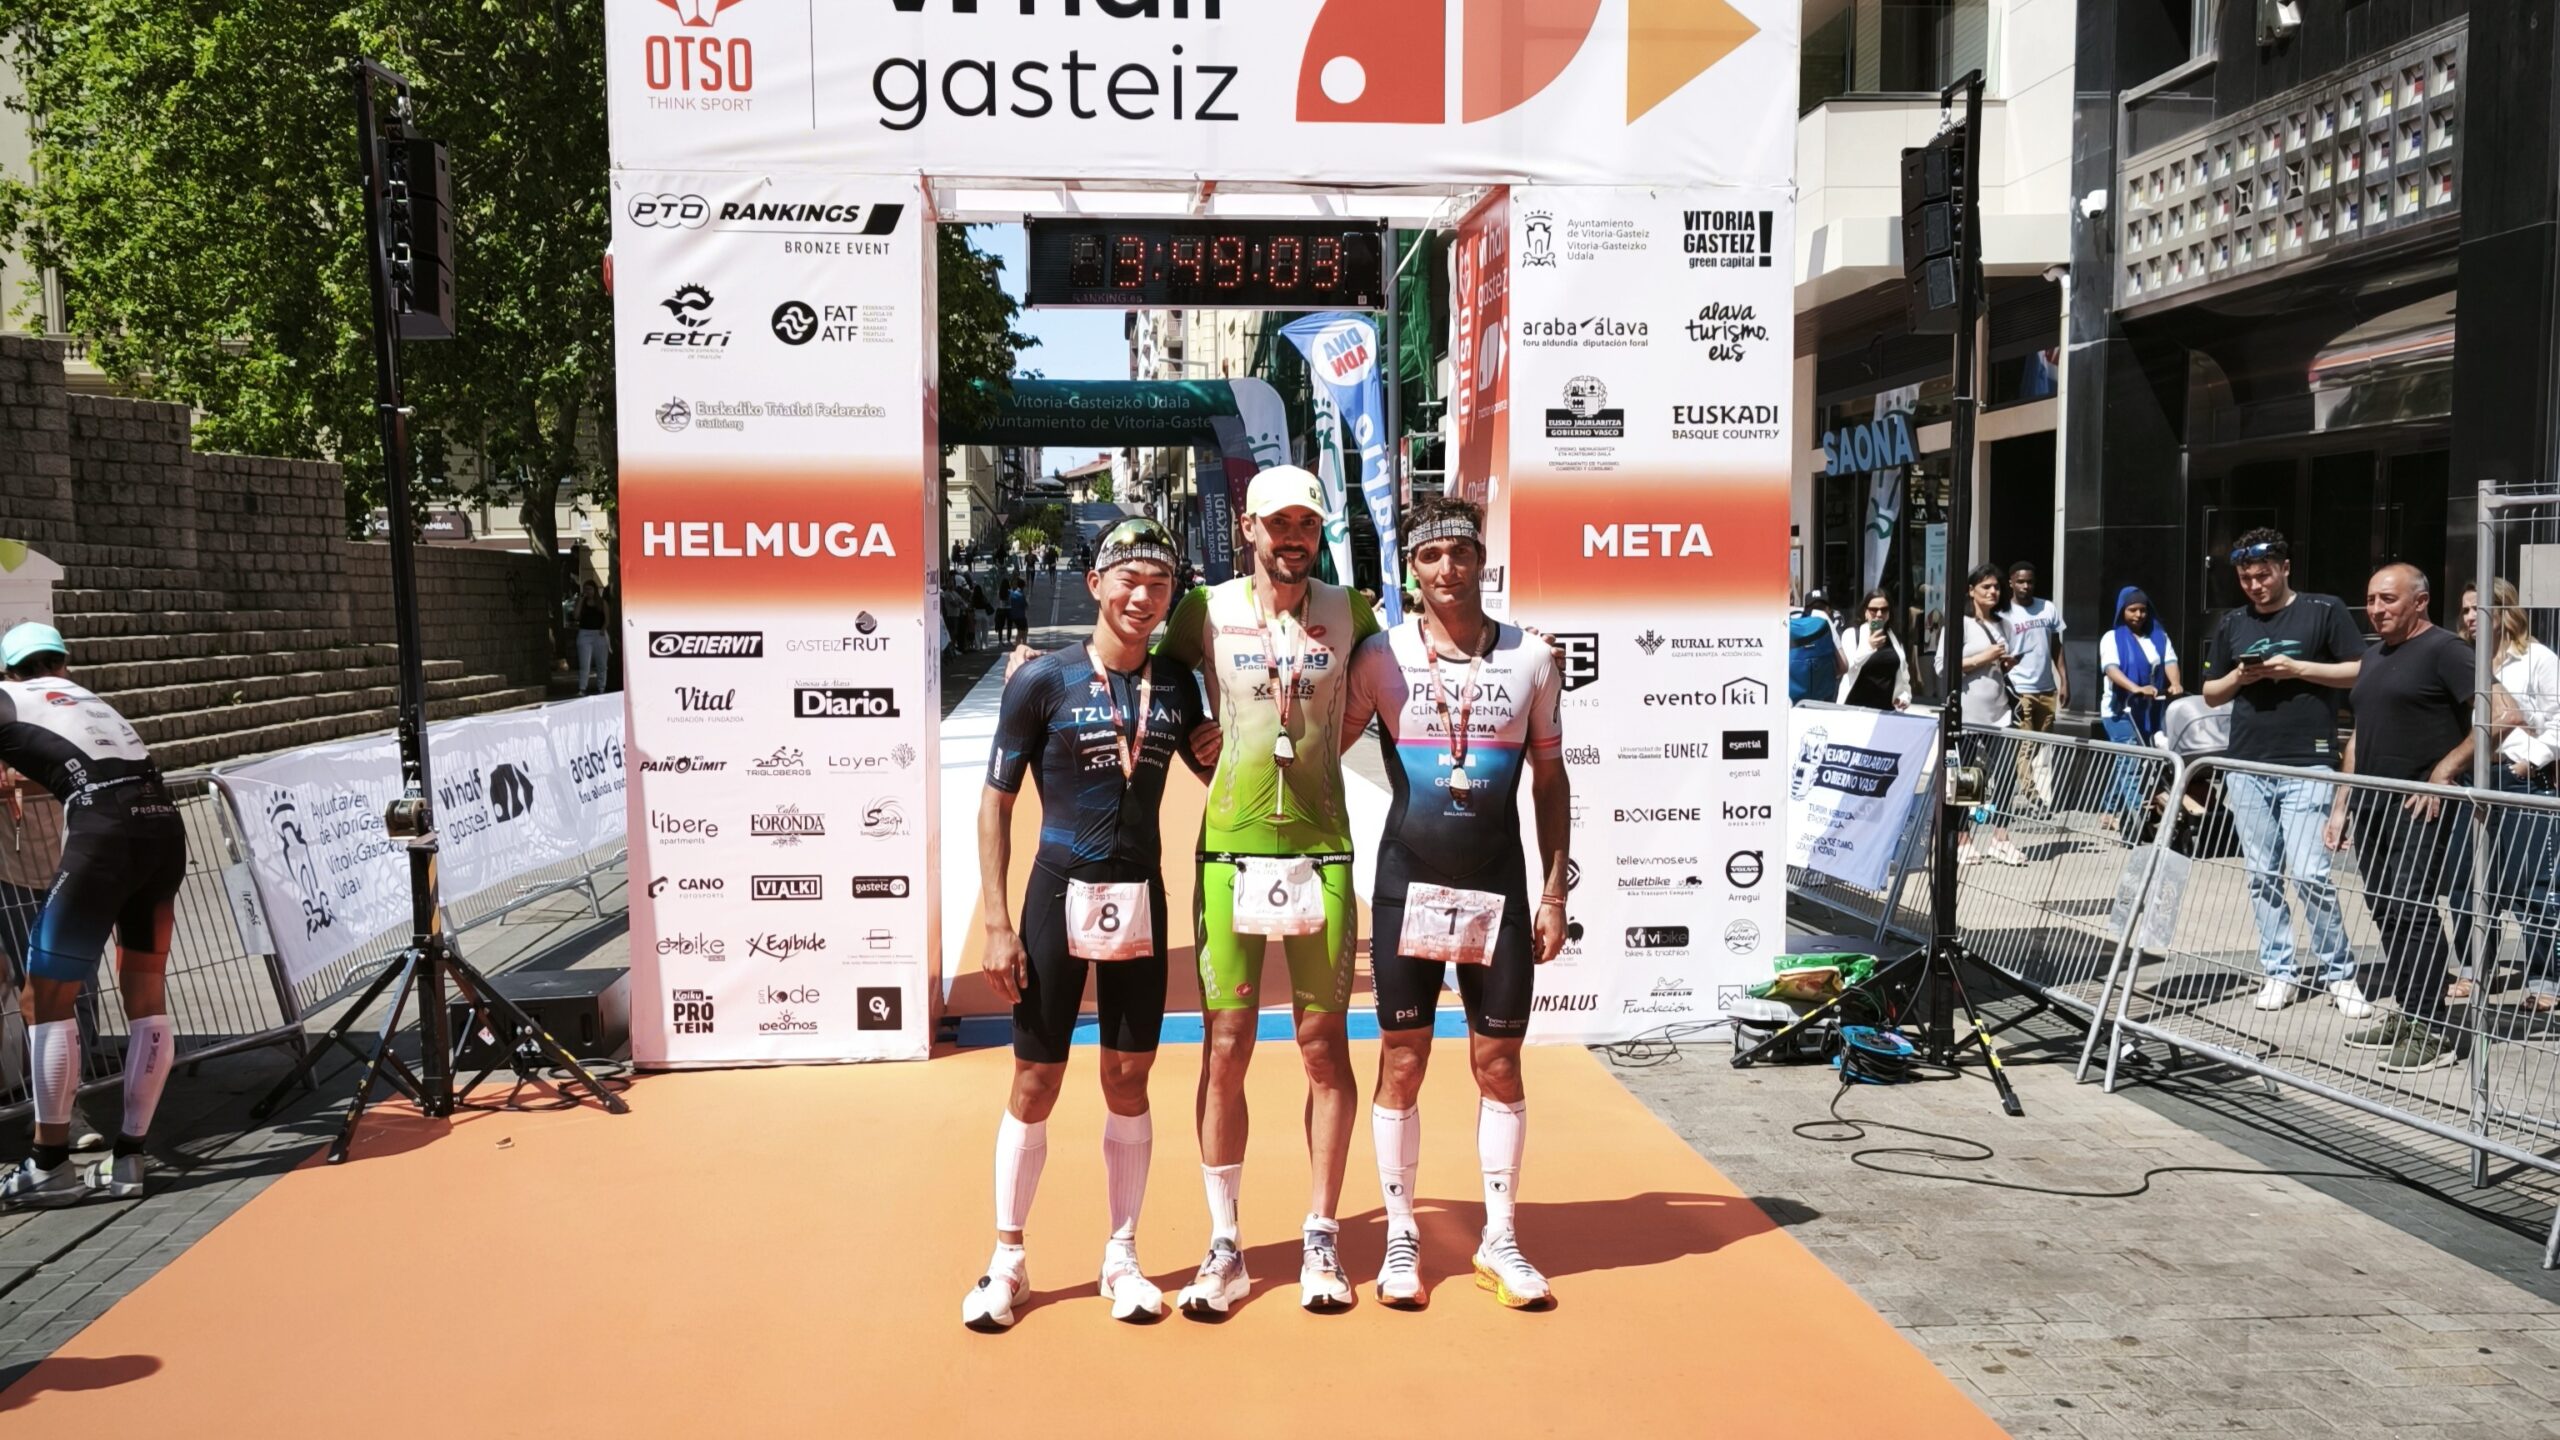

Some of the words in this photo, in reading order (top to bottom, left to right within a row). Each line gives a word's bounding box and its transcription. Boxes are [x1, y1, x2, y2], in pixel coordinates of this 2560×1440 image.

[646, 35, 752, 92] OTSO
[873, 44, 1240, 131] gasteiz
[647, 96, 696, 111] THINK
[701, 97, 753, 112] SPORT
[634, 202, 704, 219] PTO
[719, 202, 860, 223] RANKINGS
[1683, 210, 1755, 231] VITORIA
[1567, 218, 1634, 229] Ayuntamiento
[1567, 230, 1578, 238] de
[1581, 229, 1650, 239] Vitoria-Gasteiz
[785, 241, 841, 254] BRONZE
[847, 242, 890, 255] EVENT
[1567, 241, 1647, 251] Vitoria-Gasteizko
[1683, 233, 1755, 253] GASTEIZ
[1117, 236, 1341, 288] 3:49:03
[1567, 251, 1594, 260] Udala
[1689, 257, 1717, 268] green
[1720, 256, 1755, 268] capital
[824, 305, 858, 322] FAT
[821, 325, 859, 342] ATF
[1523, 318, 1577, 335] araba
[1595, 317, 1648, 335] álava
[1523, 339, 1540, 347] foru
[1542, 339, 1578, 347] aldundia
[1629, 339, 1648, 347] foral
[1709, 343, 1746, 362] eus
[696, 401, 763, 416] Euskadiko
[765, 402, 813, 416] Triatloi
[815, 402, 885, 417] Federazioa
[1012, 394, 1142, 409] Vitoria-Gasteizko
[1147, 395, 1190, 409] Udala
[979, 415, 1086, 430] Ayuntamiento
[1090, 416, 1109, 429] de
[1114, 415, 1211, 430] Vitoria-Gaste
[1672, 405, 1779, 425] EUSKADI
[1671, 430, 1719, 440] BASQUE
[1722, 430, 1780, 440] COUNTRY
[1822, 415, 1915, 476] SAONA
[643, 522, 897, 557] HELMUGA
[1583, 523, 1713, 557] META
[681, 635, 761, 655] ENERVIT
[1671, 638, 1714, 649] RURAL
[1717, 638, 1764, 649] KUTXA
[674, 687, 735, 711] Vital
[1413, 678, 1512, 703] PEÑOTA
[1643, 691, 1717, 706] evento
[1731, 687, 1756, 705] kit
[802, 690, 888, 715] Diario
[1565, 744, 1599, 757] onda
[640, 761, 674, 772] PAIN
[691, 761, 727, 771] LIMIT
[829, 755, 889, 769] Loyer
[1565, 755, 1600, 765] vasca
[438, 776, 456, 811] vi
[1723, 801, 1772, 820] kora
[751, 814, 824, 831] FORONDA
[678, 878, 725, 890] CANO
[759, 880, 816, 896] VIALKI
[855, 882, 889, 894] gasteiz
[1618, 876, 1671, 887] bulletbike
[1268, 879, 1289, 907] 6
[1728, 893, 1760, 903] Arregui
[1098, 902, 1121, 933] 8
[1444, 907, 1458, 936] 1
[766, 932, 827, 962] Egibide
[1531, 994, 1598, 1012] INSALUS
[1623, 1000, 1694, 1014] Fundación
[1395, 1005, 1419, 1023] psi
[673, 1022, 714, 1034] TEIN
